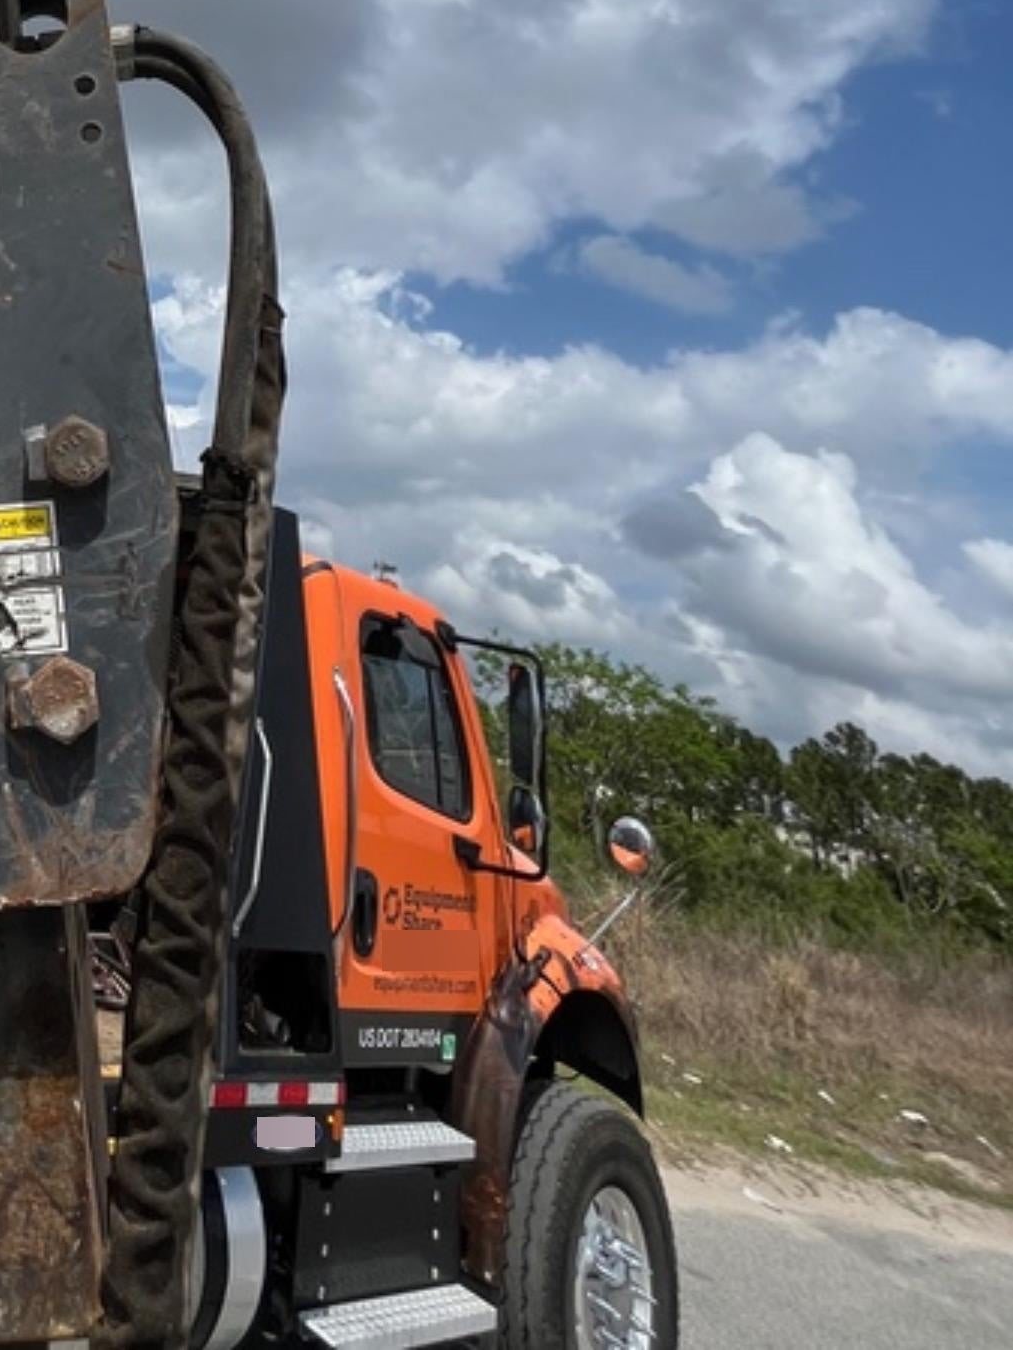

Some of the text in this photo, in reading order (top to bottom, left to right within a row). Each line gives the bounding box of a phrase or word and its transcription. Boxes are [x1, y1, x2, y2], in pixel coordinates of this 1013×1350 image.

[404, 882, 476, 913] Equipment
[404, 910, 443, 931] Share
[358, 1027, 375, 1048] US
[376, 1027, 401, 1048] DOT
